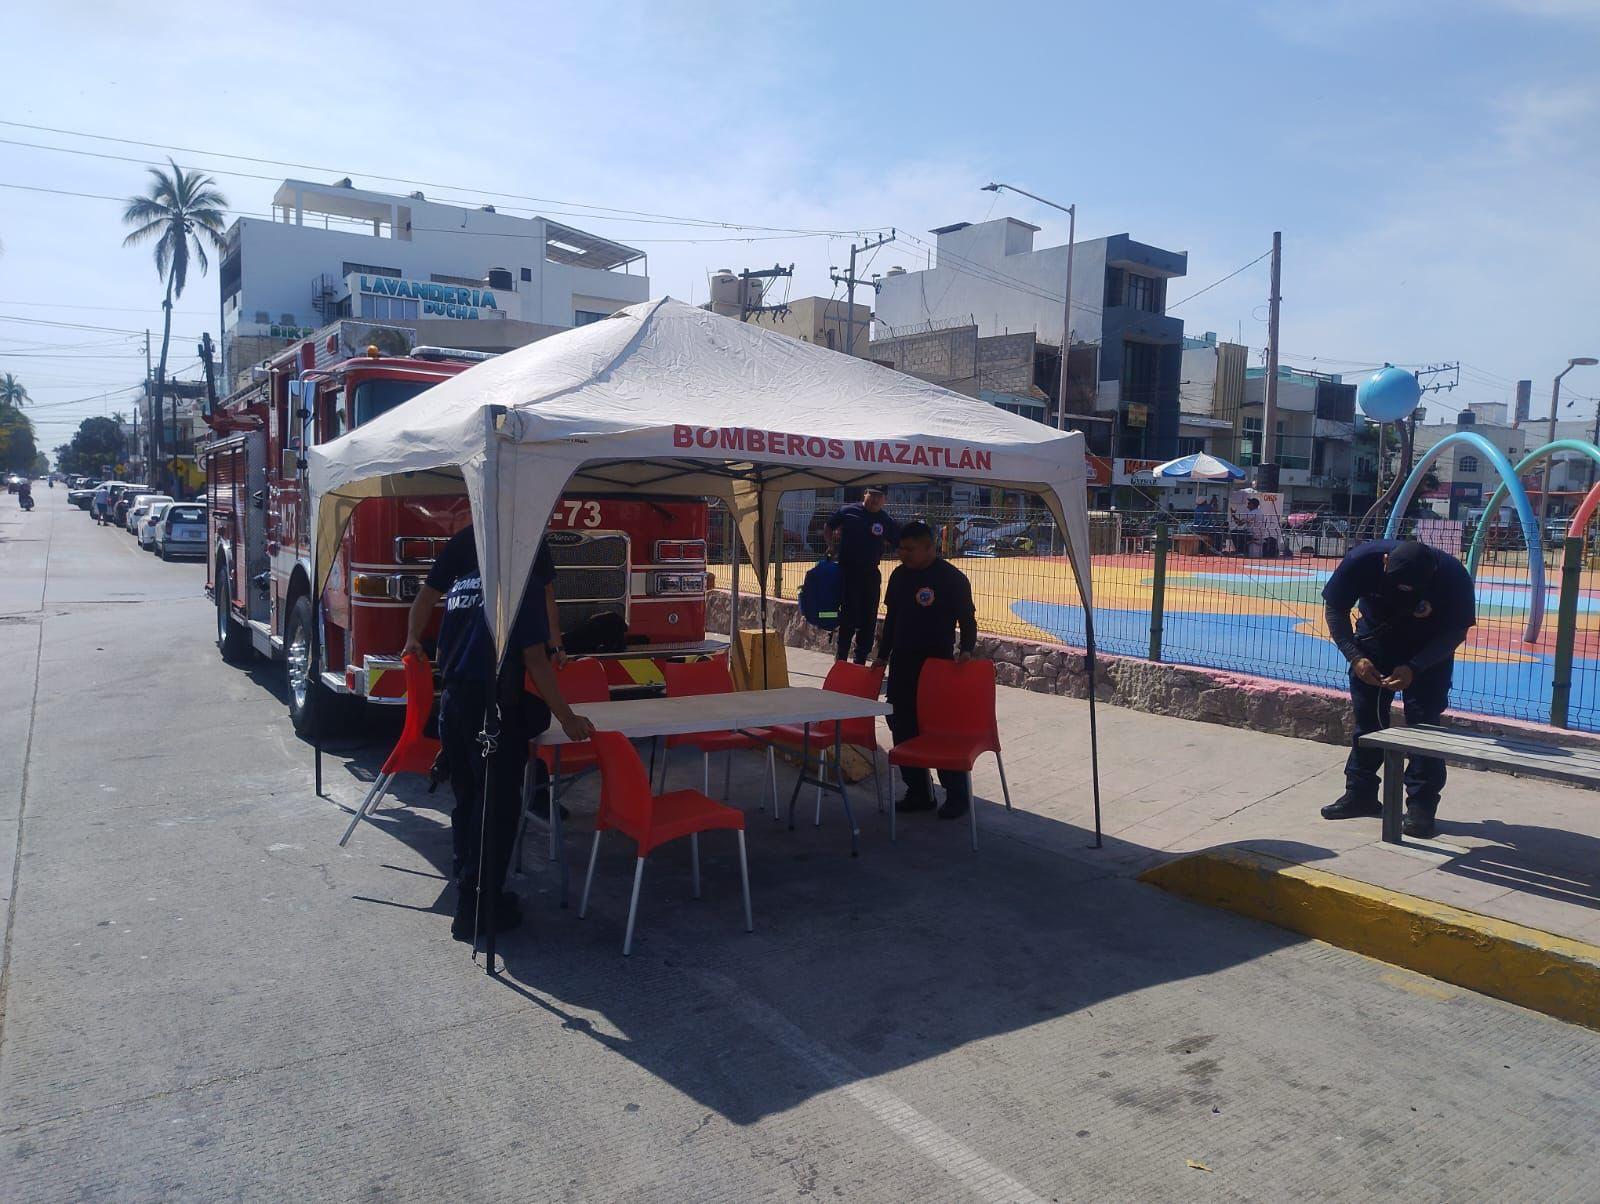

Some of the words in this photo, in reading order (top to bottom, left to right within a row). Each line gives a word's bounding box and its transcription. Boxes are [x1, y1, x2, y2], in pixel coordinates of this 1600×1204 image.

[360, 275, 498, 309] LAVANDERIA
[424, 301, 480, 320] DUCHA
[673, 424, 845, 460] BOMBEROS
[854, 440, 992, 471] MAZATLÁN
[547, 500, 602, 528] -73
[451, 577, 482, 592] BOMB
